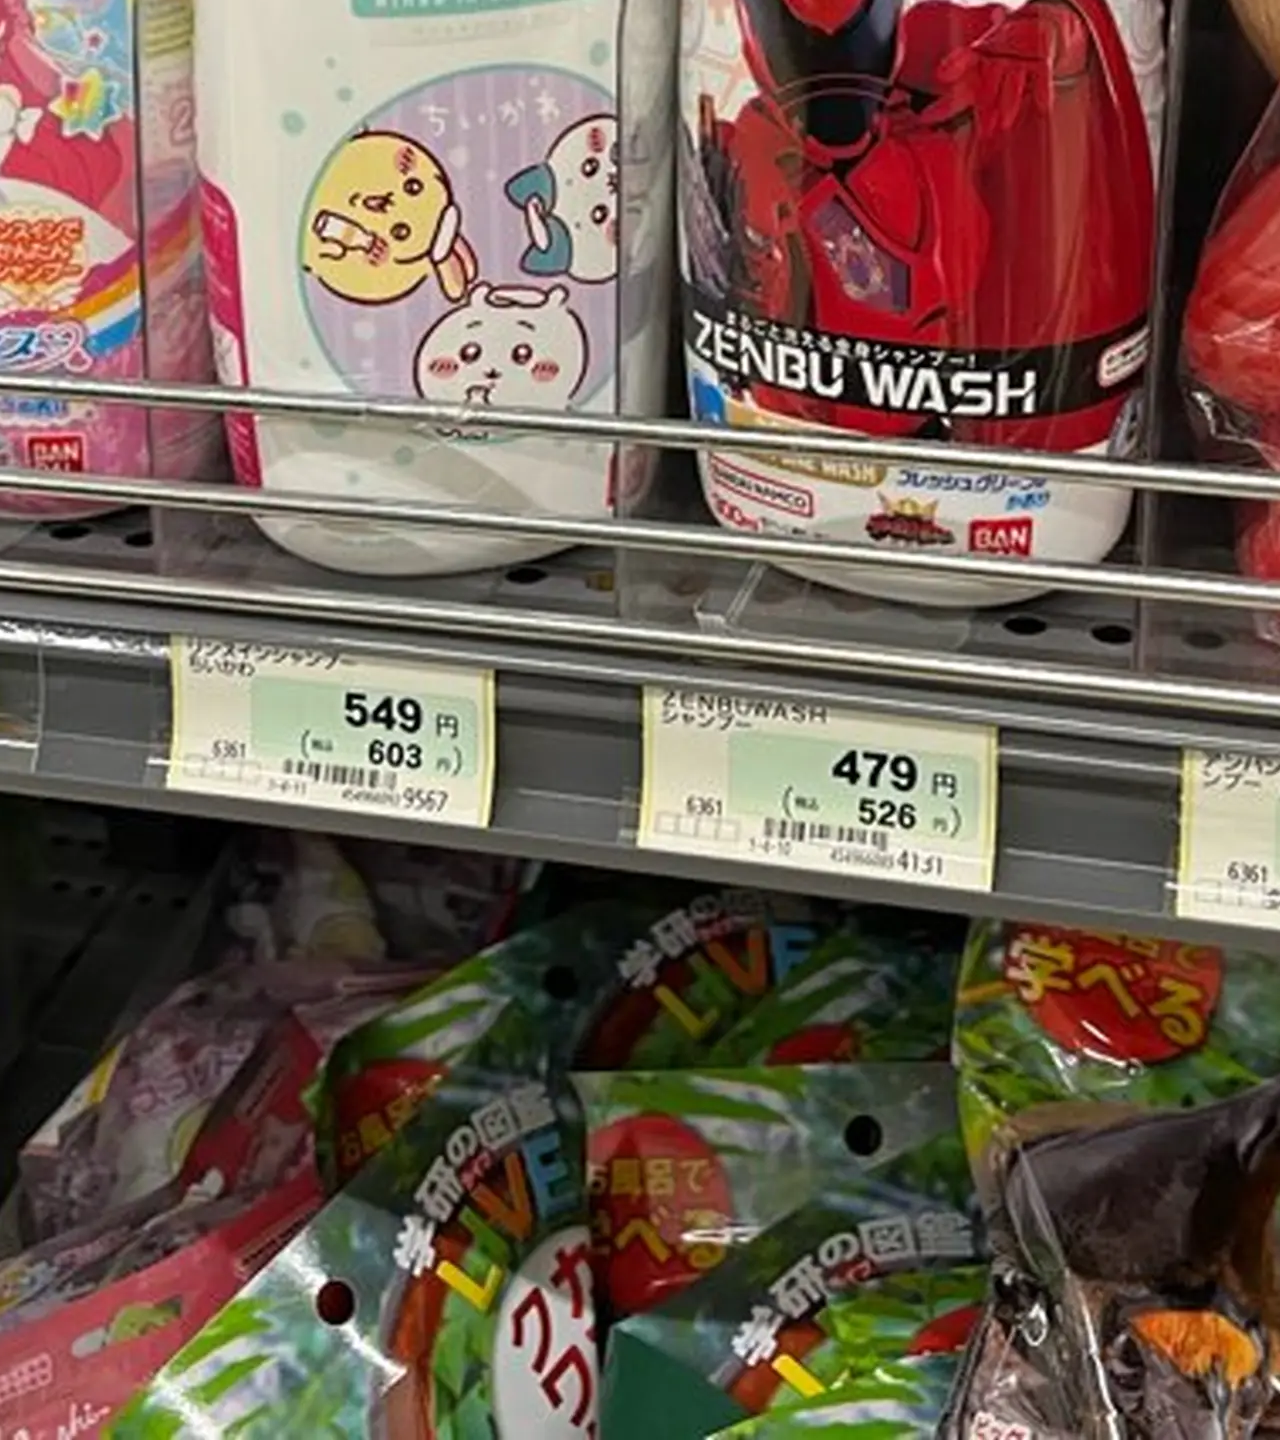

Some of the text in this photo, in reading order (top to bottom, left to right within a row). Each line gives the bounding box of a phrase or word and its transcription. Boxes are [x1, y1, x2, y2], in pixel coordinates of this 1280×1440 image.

[692, 310, 1037, 415] ZENBU WASH
[973, 529, 1028, 550] BAN
[369, 740, 422, 769] 603
[686, 796, 722, 816] 6361
[858, 800, 916, 829] 526
[1227, 862, 1268, 883] 6361
[1006, 932, 1204, 1046] 学べる
